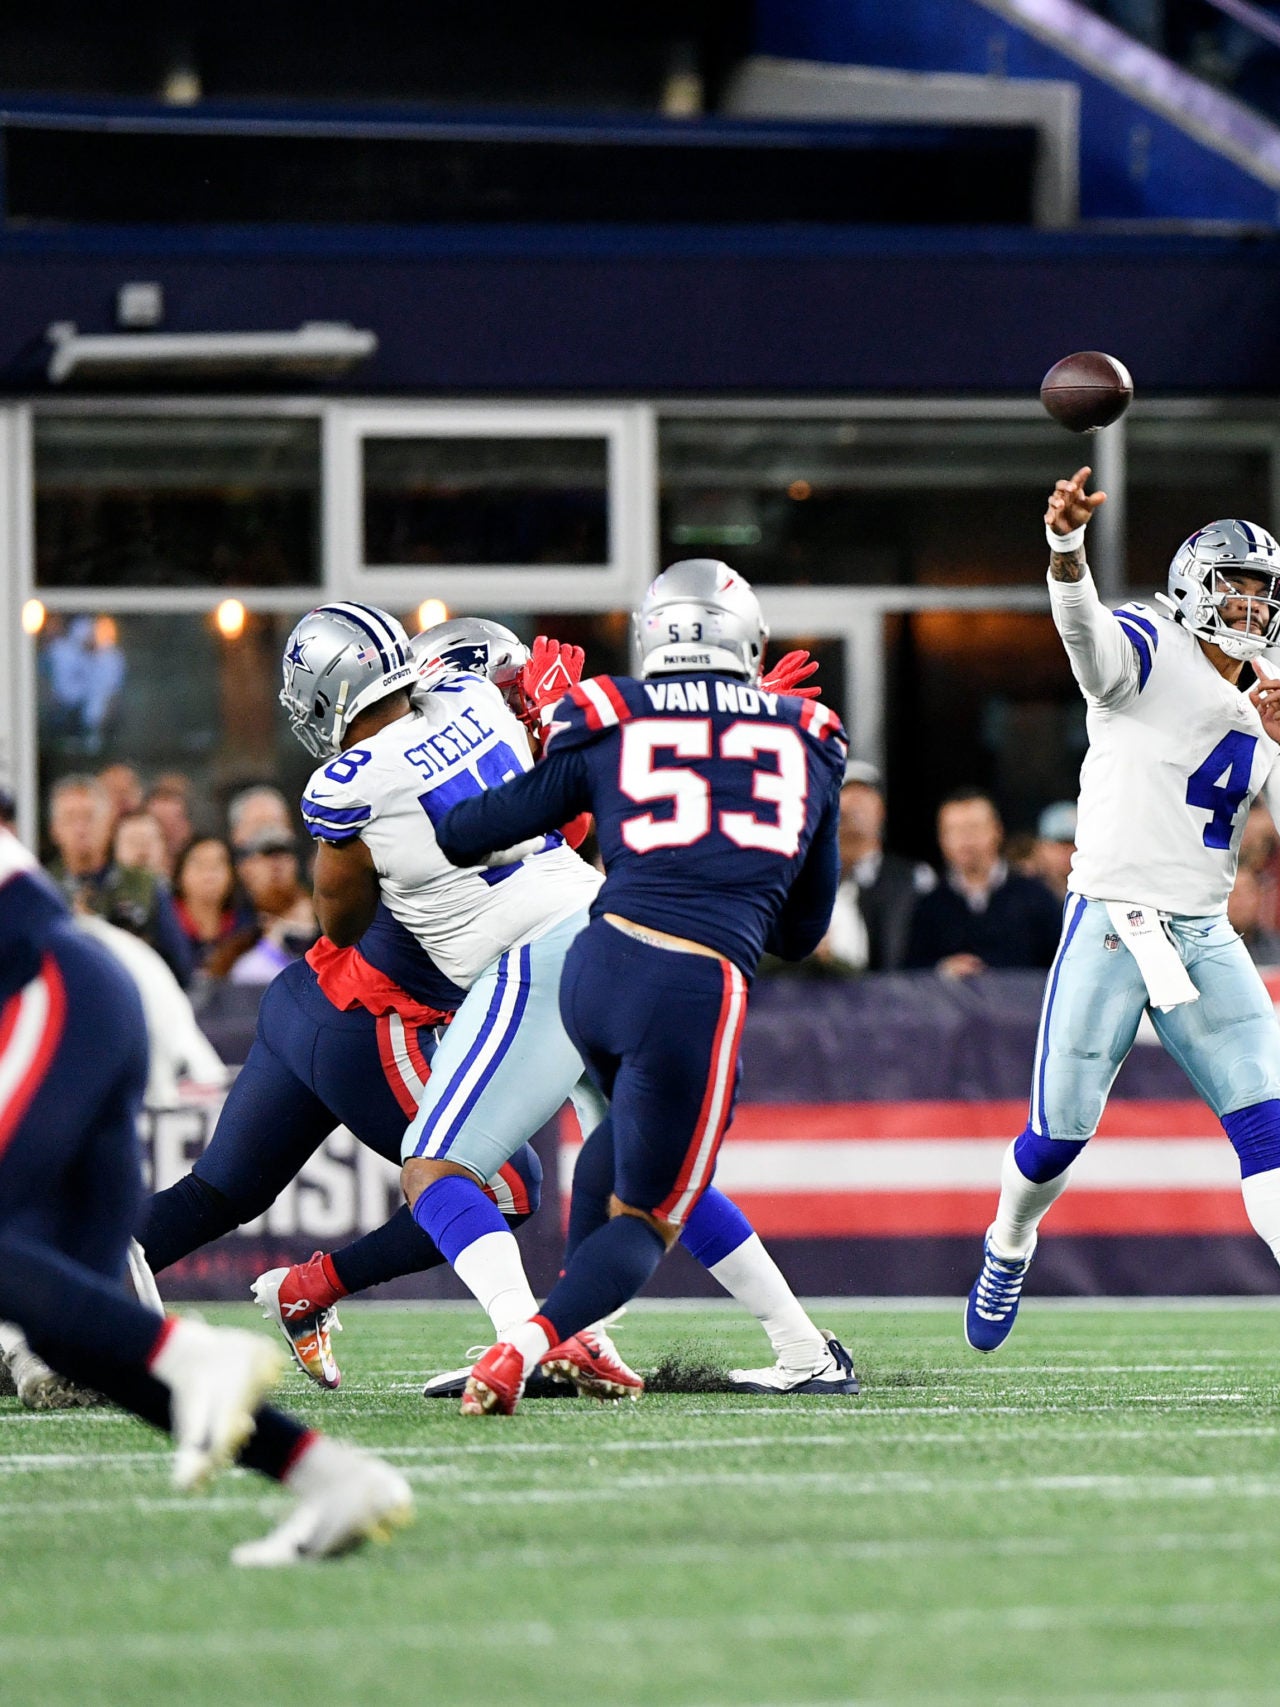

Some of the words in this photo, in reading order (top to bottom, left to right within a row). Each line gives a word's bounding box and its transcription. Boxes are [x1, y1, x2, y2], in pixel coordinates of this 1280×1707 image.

[664, 654, 711, 665] PATRIOTS
[643, 680, 710, 712] VAN
[715, 681, 779, 716] NOY
[324, 749, 372, 784] 8
[403, 706, 495, 780] STEELE
[619, 717, 809, 860] 53
[1185, 729, 1259, 851] 4
